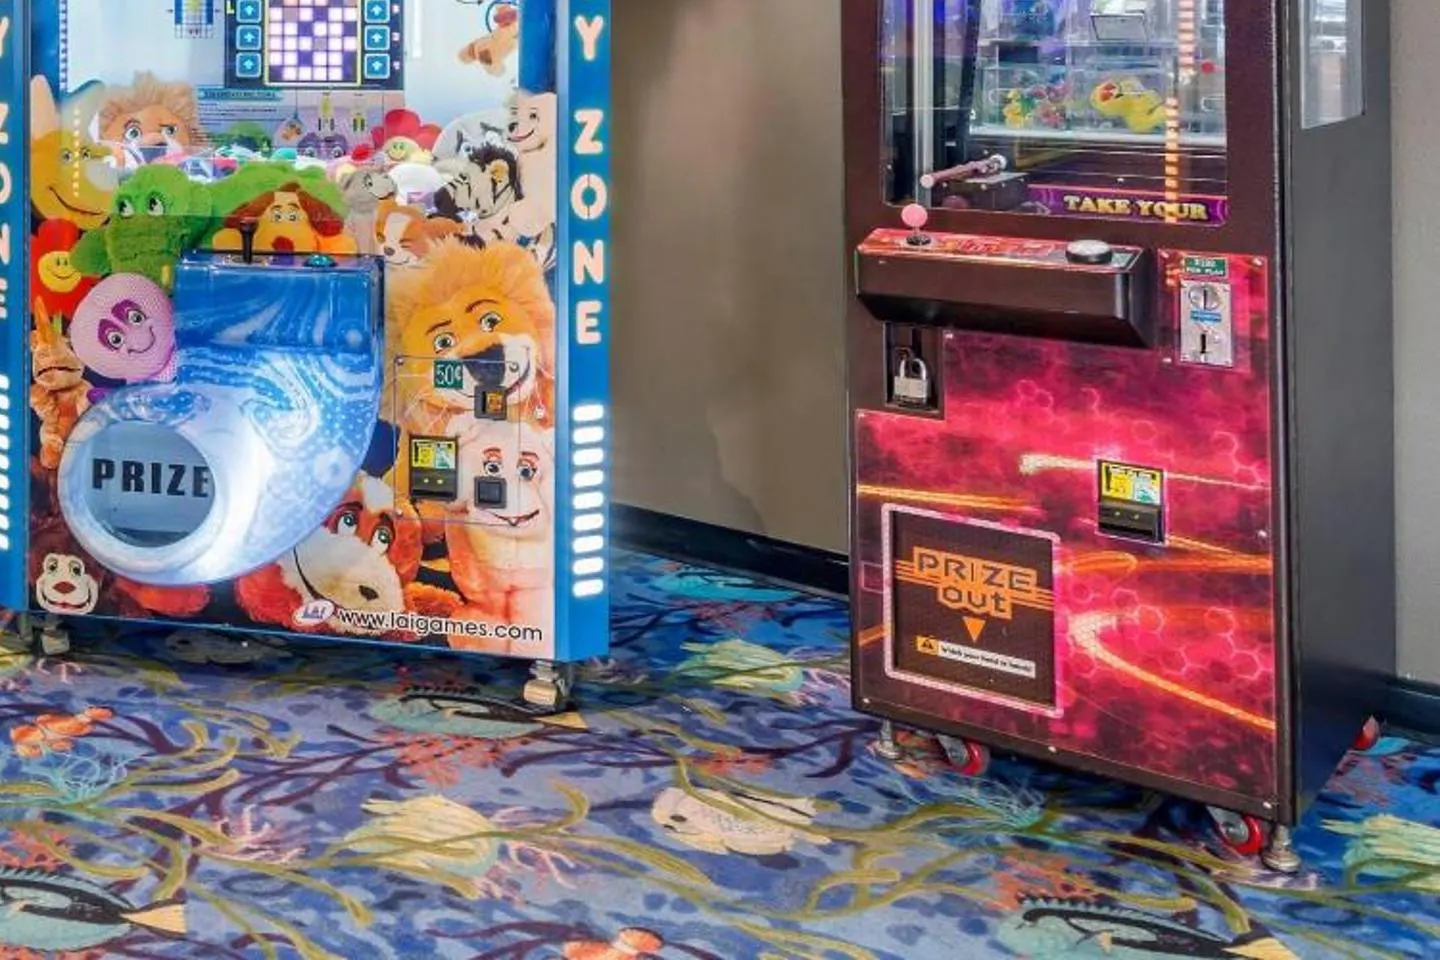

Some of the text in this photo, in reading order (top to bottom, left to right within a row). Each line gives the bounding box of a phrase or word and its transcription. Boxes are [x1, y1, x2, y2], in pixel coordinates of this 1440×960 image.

[1063, 195, 1208, 220] TAKE YOUR
[570, 109, 608, 344] ZONE
[436, 363, 463, 385] 50¢
[92, 458, 209, 498] PRIZE
[918, 553, 1033, 594] PRIZE
[337, 609, 543, 641] www.laigames.com
